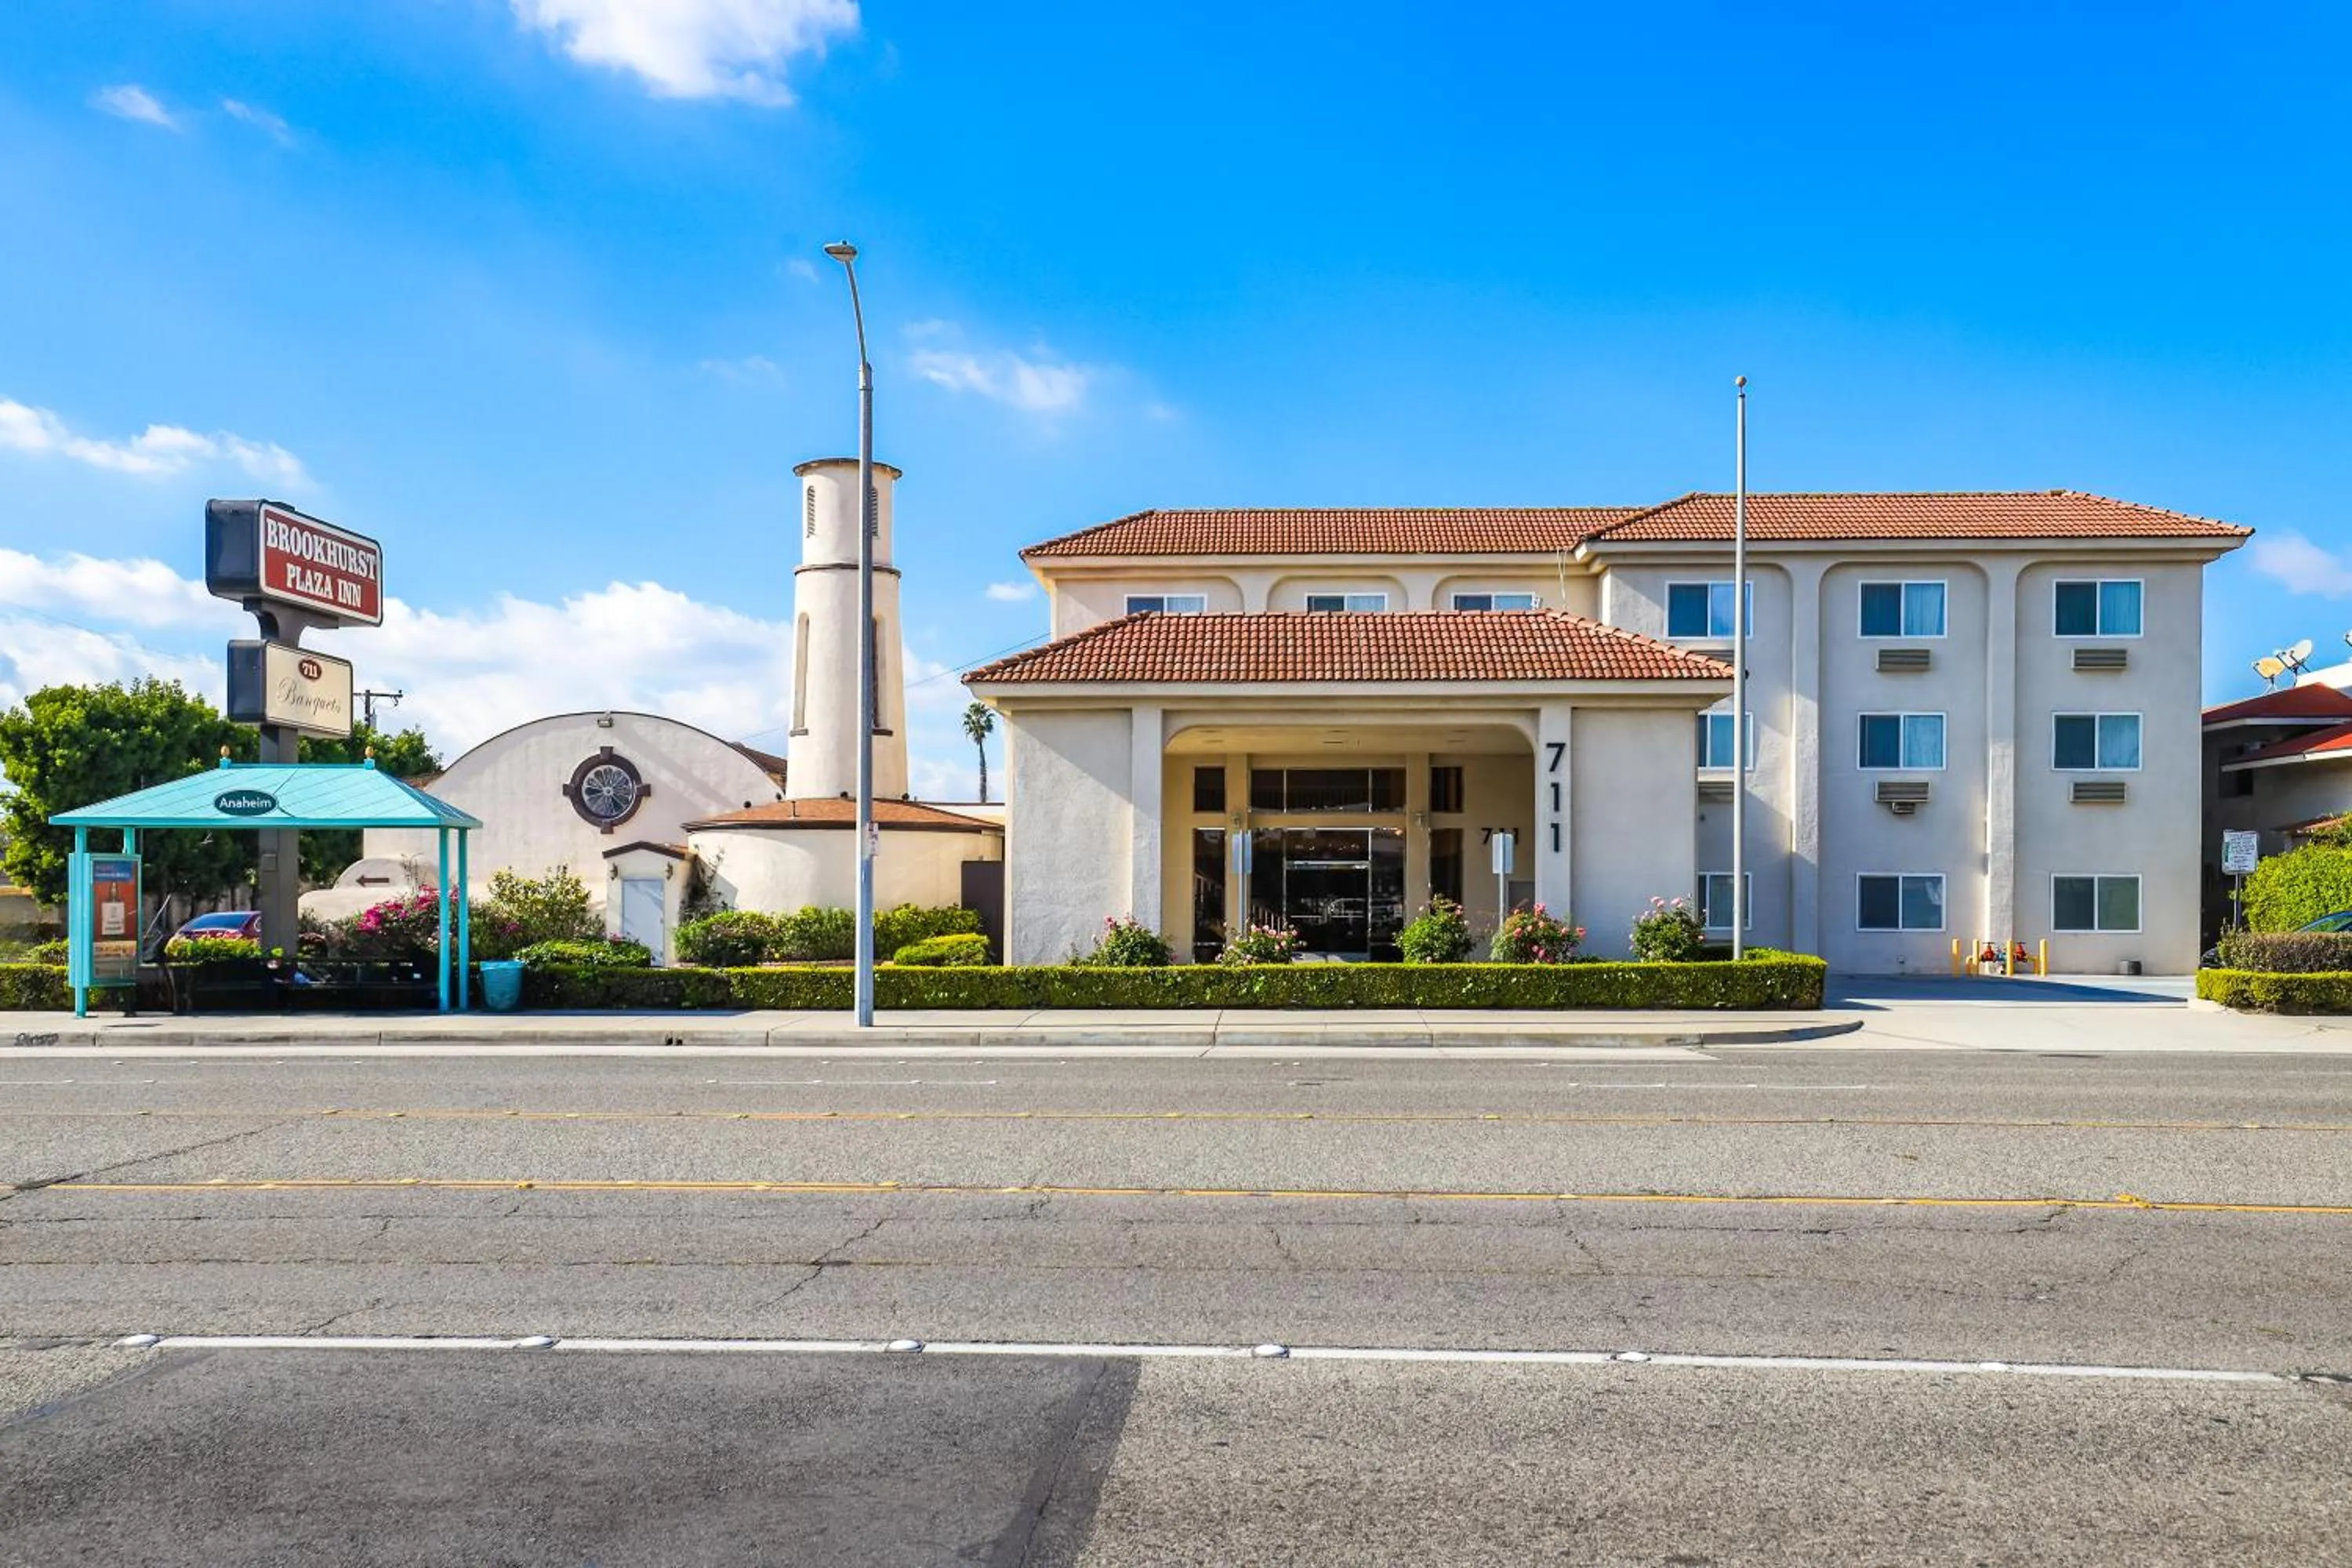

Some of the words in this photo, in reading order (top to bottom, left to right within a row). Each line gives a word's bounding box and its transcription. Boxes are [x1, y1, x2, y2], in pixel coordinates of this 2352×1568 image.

[267, 517, 376, 579] BROOKHURST
[286, 562, 333, 599] PLAZA
[337, 579, 361, 608] INN
[303, 662, 318, 678] 711
[220, 796, 272, 808] Anaheim
[1546, 743, 1566, 853] 711
